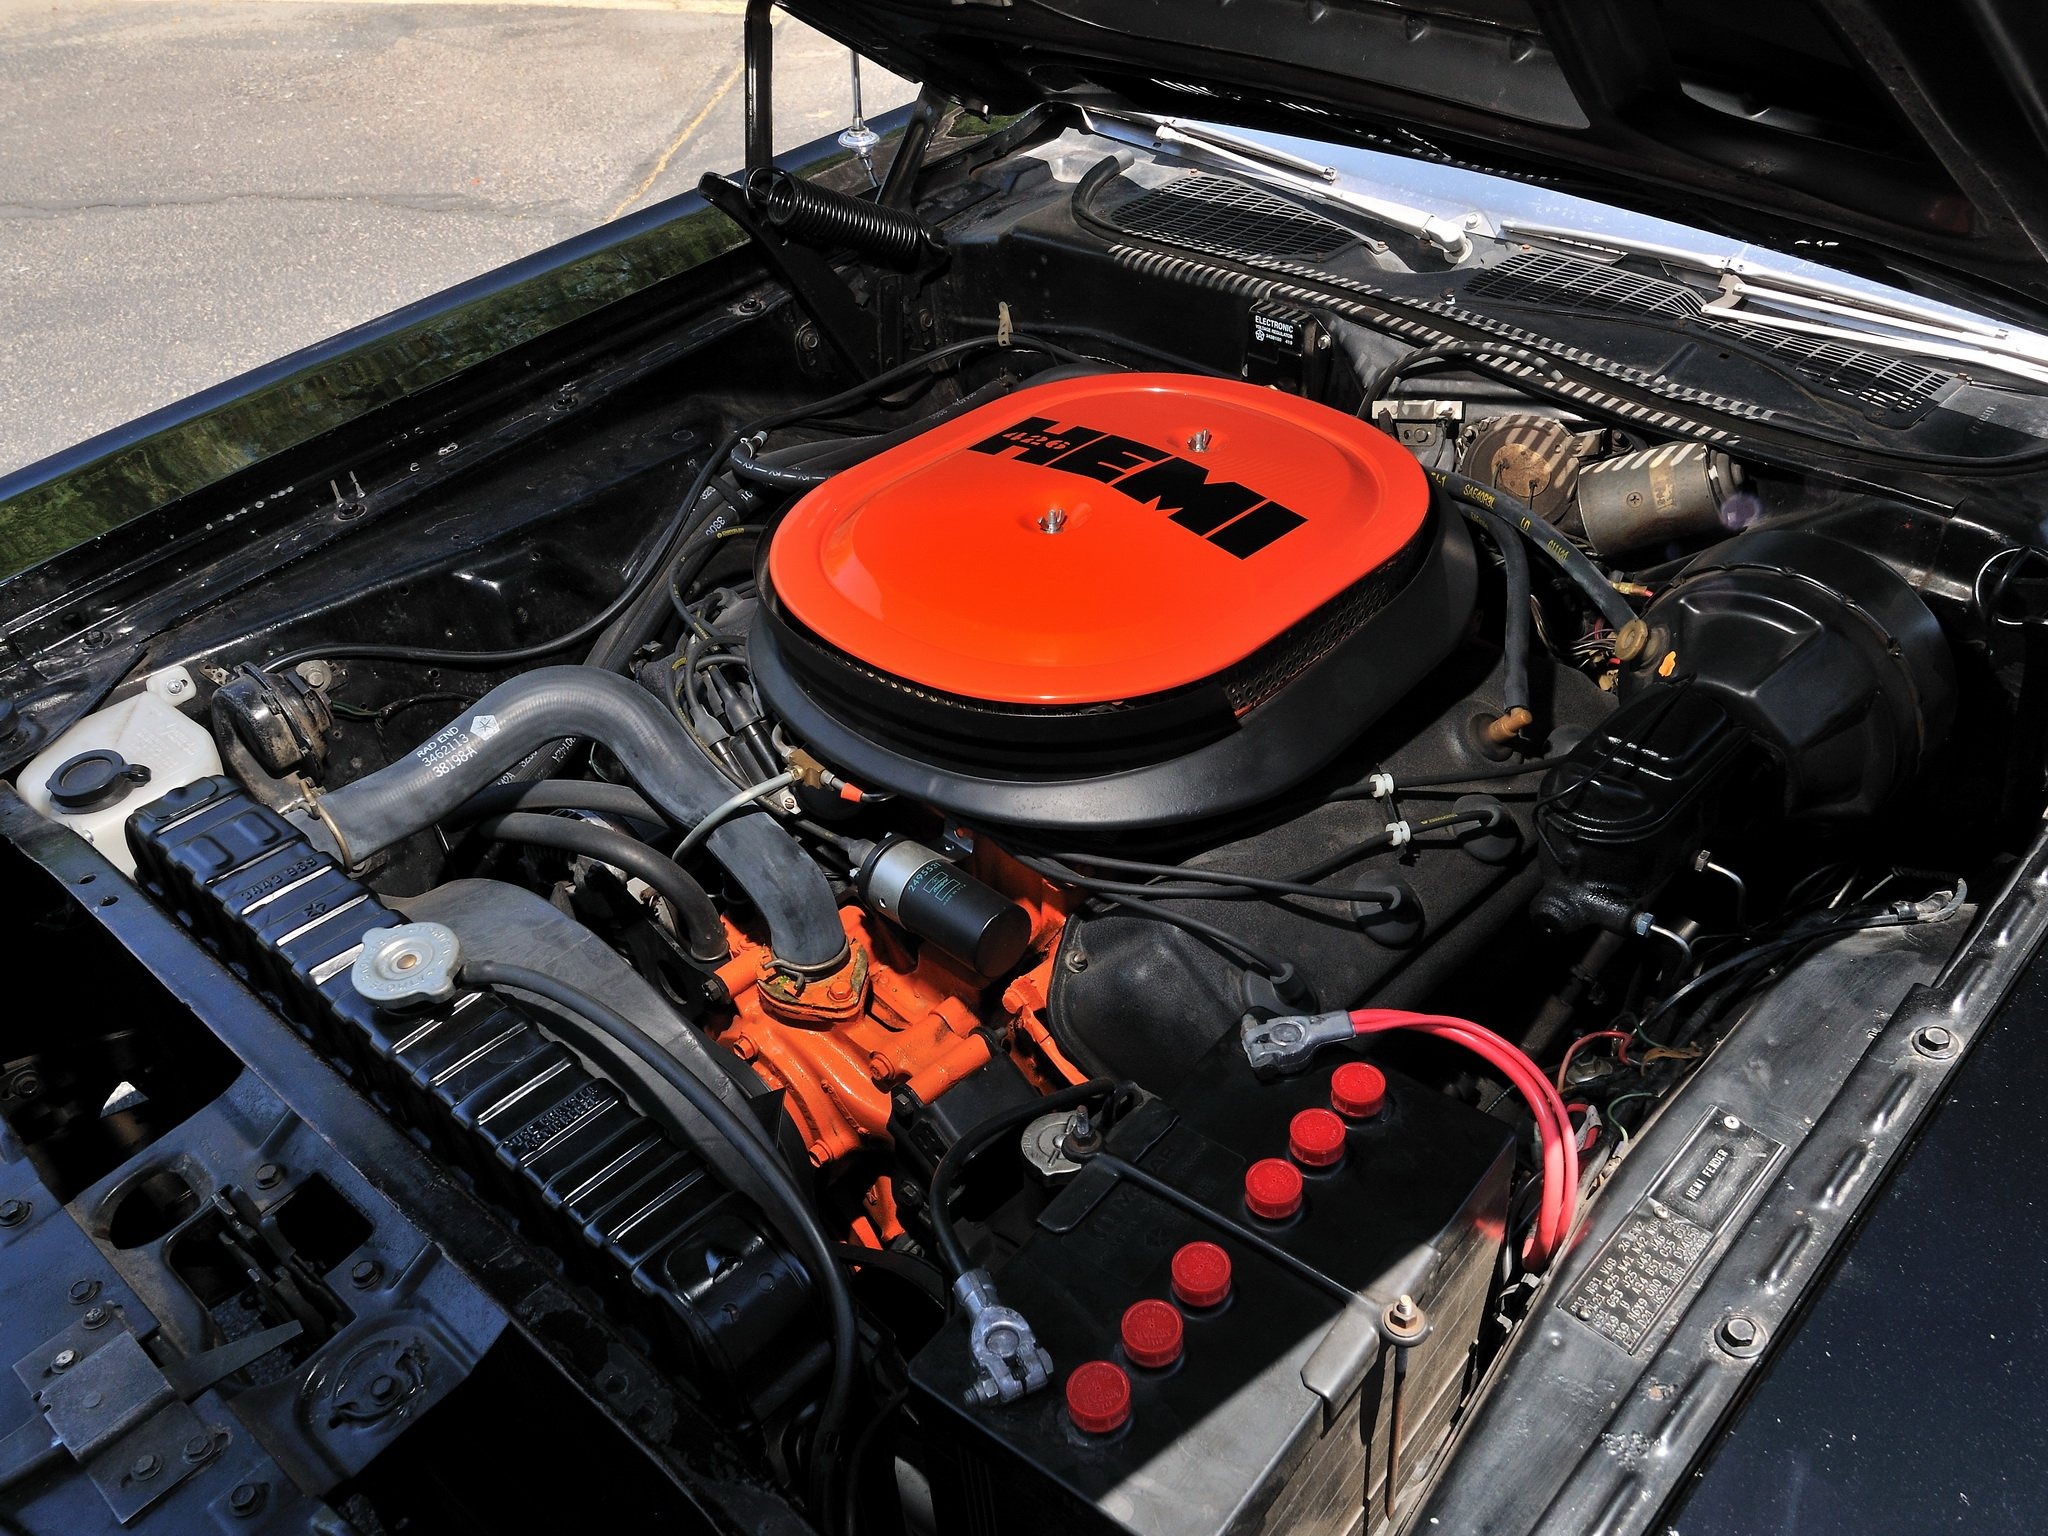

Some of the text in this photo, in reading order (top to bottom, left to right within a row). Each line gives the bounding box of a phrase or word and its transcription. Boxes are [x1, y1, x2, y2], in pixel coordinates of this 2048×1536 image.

[1255, 316, 1294, 332] ELECTRONIC
[1002, 432, 1070, 449] 426
[967, 416, 1309, 560] HEMI
[416, 726, 458, 758] RAD END
[422, 733, 469, 767] 3462113
[908, 862, 941, 892] 2495531
[1700, 1147, 1729, 1178] FENDER
[1616, 1238, 1632, 1252] 26
[1616, 1254, 1635, 1272] N41
[1630, 1235, 1649, 1254] N42
[1620, 1269, 1639, 1288] J25
[1634, 1250, 1653, 1270] J45
[1648, 1232, 1667, 1251] J46
[1630, 1276, 1649, 1295] A34
[1644, 1257, 1663, 1276] B51
[1658, 1238, 1677, 1258] C55
[1658, 1259, 1676, 1278] C11
[1636, 1308, 1656, 1328] D21
